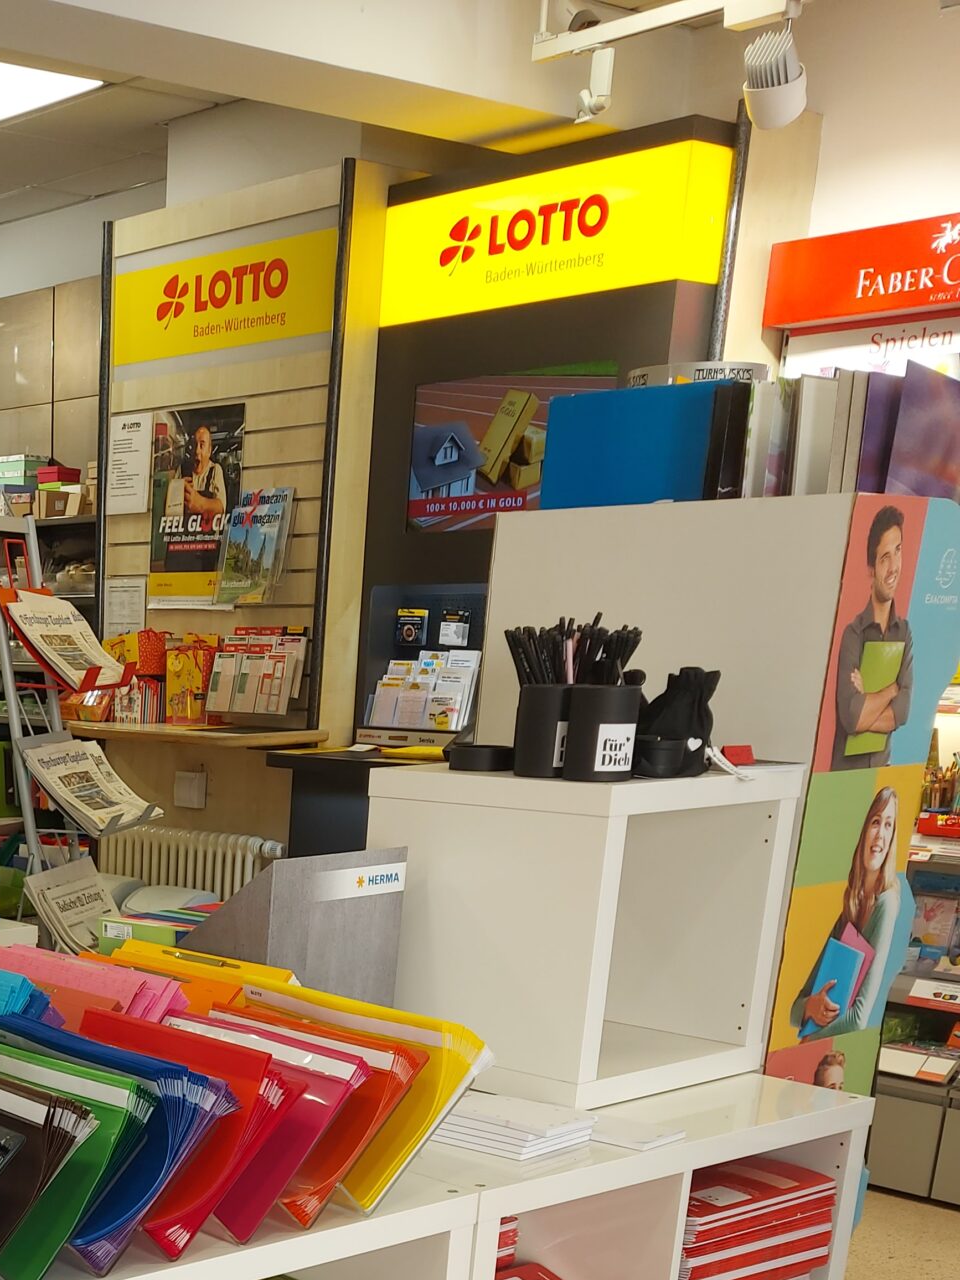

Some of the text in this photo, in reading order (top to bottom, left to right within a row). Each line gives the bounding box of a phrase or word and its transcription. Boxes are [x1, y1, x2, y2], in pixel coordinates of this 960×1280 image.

[487, 193, 609, 256] LOTTO
[485, 252, 605, 284] Baden-Württemberg
[194, 257, 289, 313] LOTTO
[193, 311, 287, 338] Baden-Württemberg
[869, 326, 953, 358] Spielen
[487, 499, 496, 507] IN
[499, 497, 523, 507] GOLD
[159, 515, 184, 534] FEEL
[602, 738, 625, 752] für
[600, 752, 630, 767] Dich
[367, 872, 400, 887] HERMA
[82, 892, 105, 905] Zeitung
